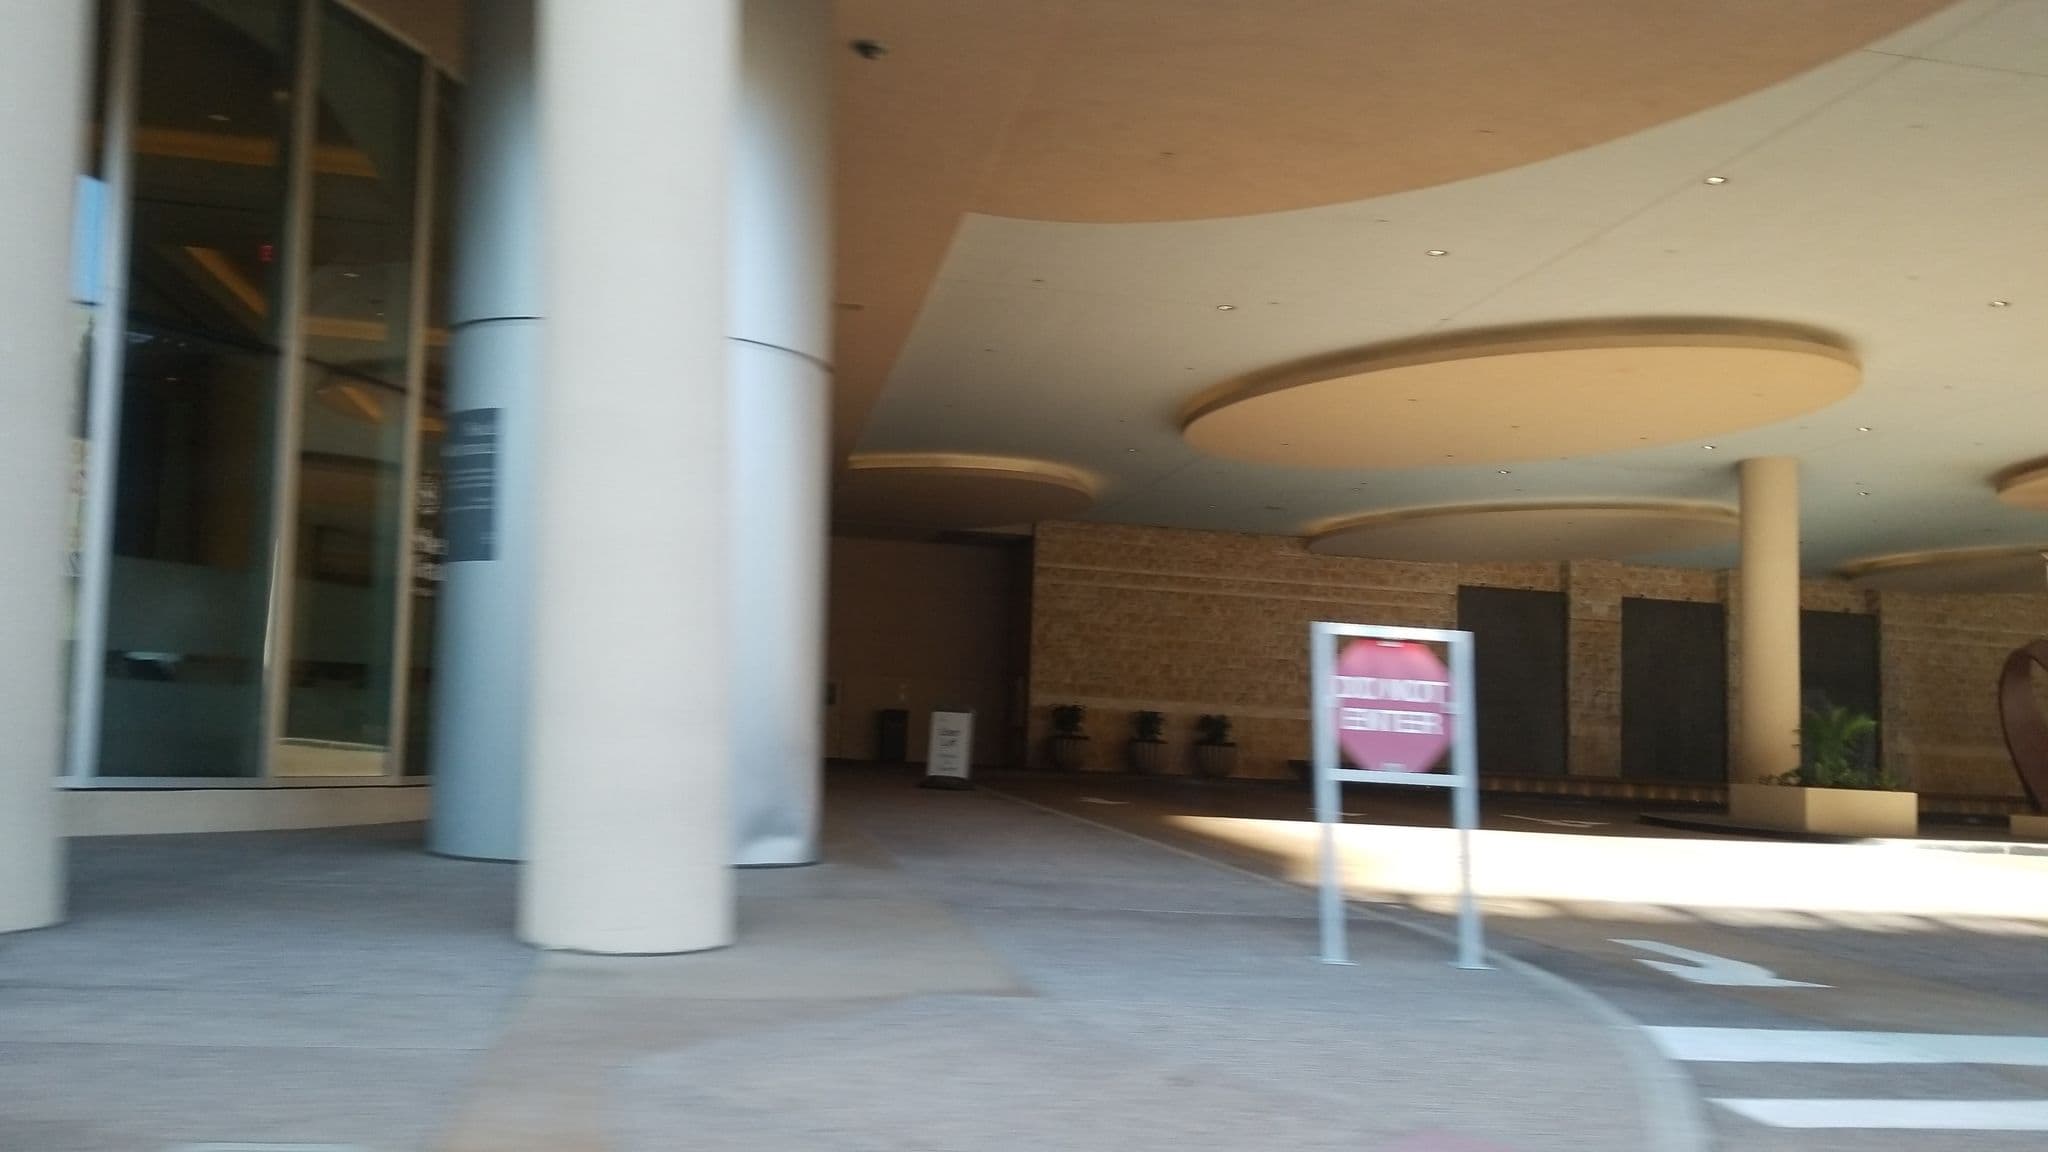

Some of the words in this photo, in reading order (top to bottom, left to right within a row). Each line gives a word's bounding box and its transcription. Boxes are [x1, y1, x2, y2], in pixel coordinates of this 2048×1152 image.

[1333, 676, 1375, 699] DO
[1378, 678, 1450, 703] NOT
[1339, 707, 1444, 735] ENTER
